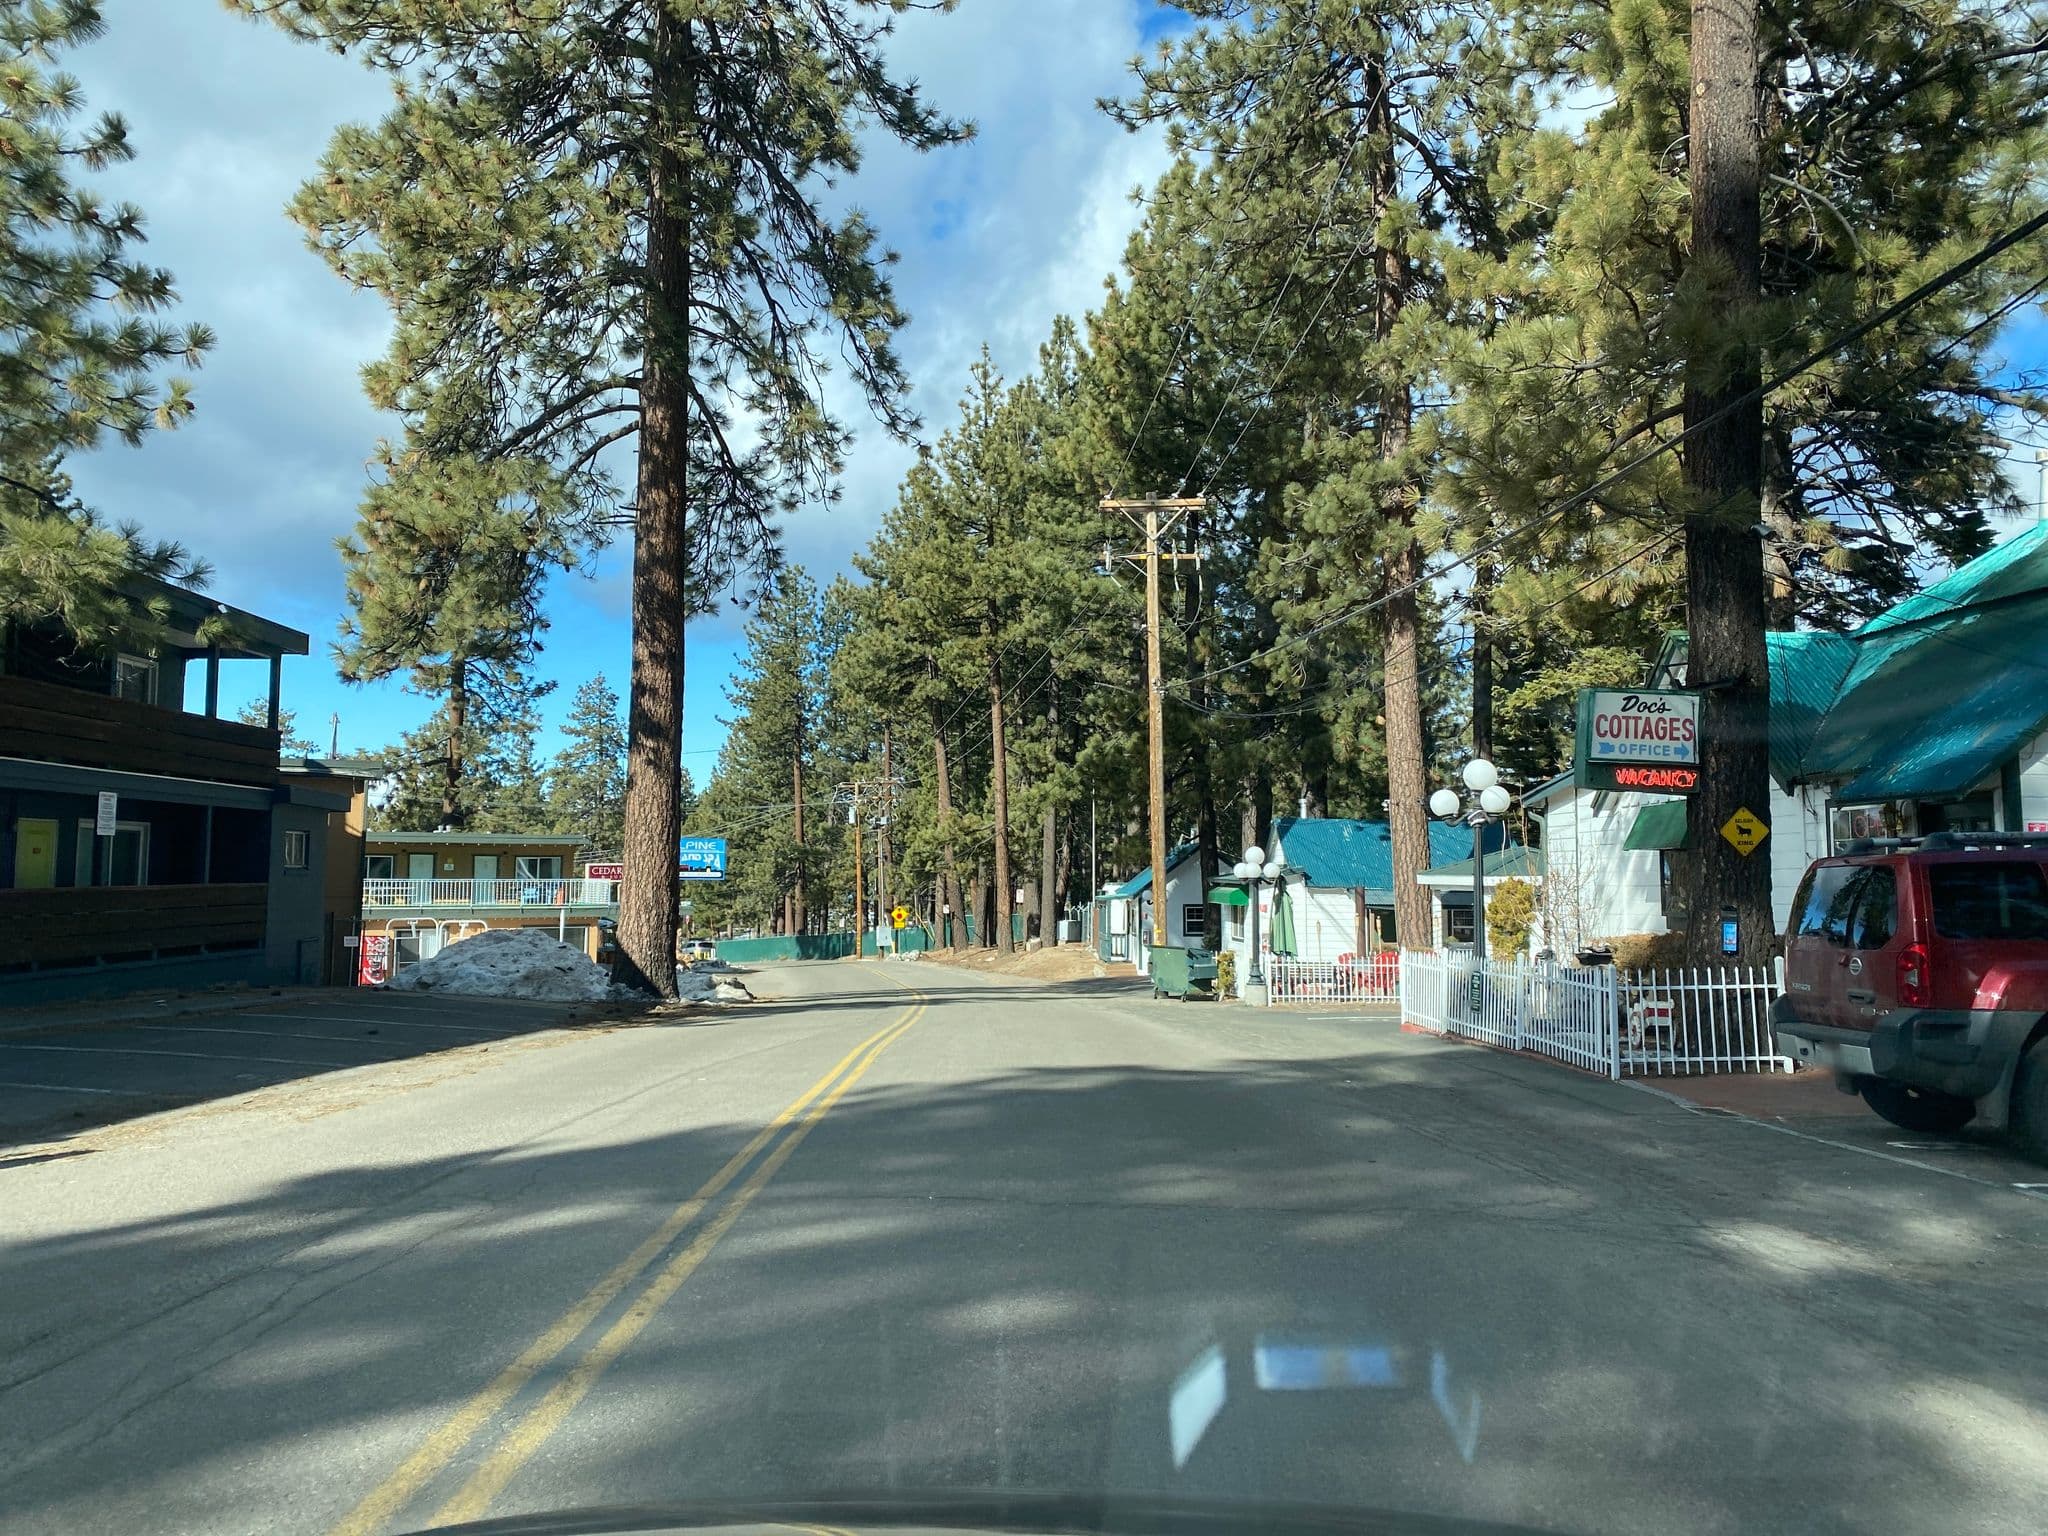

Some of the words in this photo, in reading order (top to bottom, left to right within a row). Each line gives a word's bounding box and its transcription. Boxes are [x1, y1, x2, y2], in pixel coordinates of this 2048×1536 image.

[1621, 695, 1672, 713] Doc's
[1595, 714, 1695, 742] COTTAGES
[1618, 743, 1671, 756] OFFICE
[1615, 768, 1697, 787] VACANCY
[592, 867, 623, 876] CEDAR
